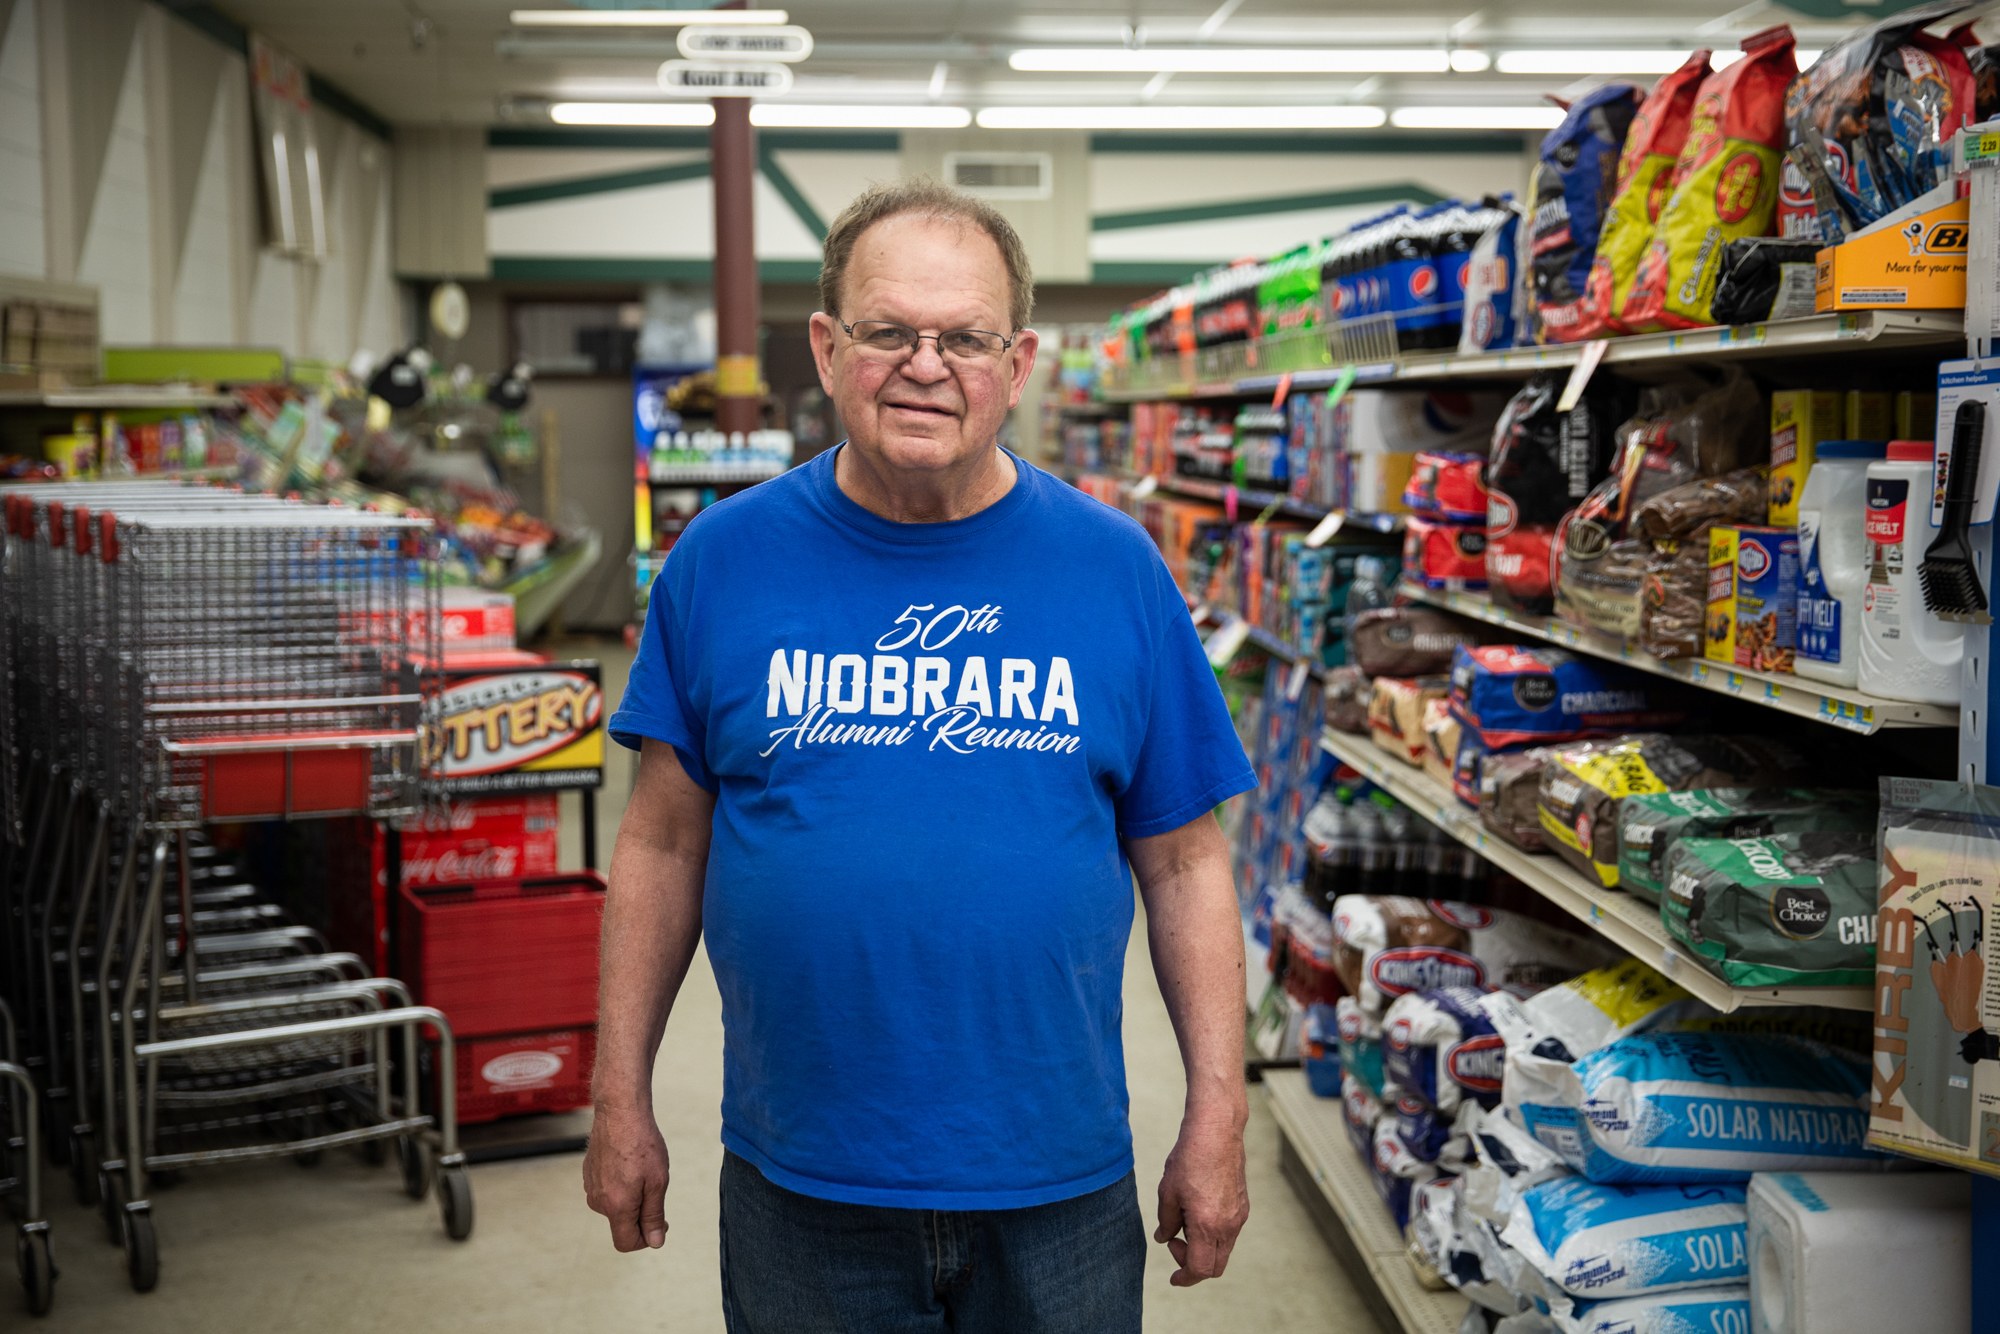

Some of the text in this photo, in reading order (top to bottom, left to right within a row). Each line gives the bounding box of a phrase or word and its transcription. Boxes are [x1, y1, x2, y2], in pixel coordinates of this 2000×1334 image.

[1931, 229, 1968, 248] BI
[1886, 262, 1911, 273] More
[1914, 260, 1927, 273] for
[1930, 264, 1950, 277] your
[1941, 375, 1988, 385] kitchen helpers
[1876, 522, 1900, 535] MELT
[875, 603, 1004, 651] 50th
[766, 649, 1079, 726] NIOBRARA
[758, 702, 1082, 758] Alumni Reunion
[1779, 909, 1827, 922] Choice
[1787, 898, 1816, 910] Best
[1869, 847, 1918, 1123] KIRBY
[1455, 1049, 1504, 1081] KING
[1687, 1103, 1763, 1141] SOLAR
[1685, 1231, 1748, 1274] SOLA
